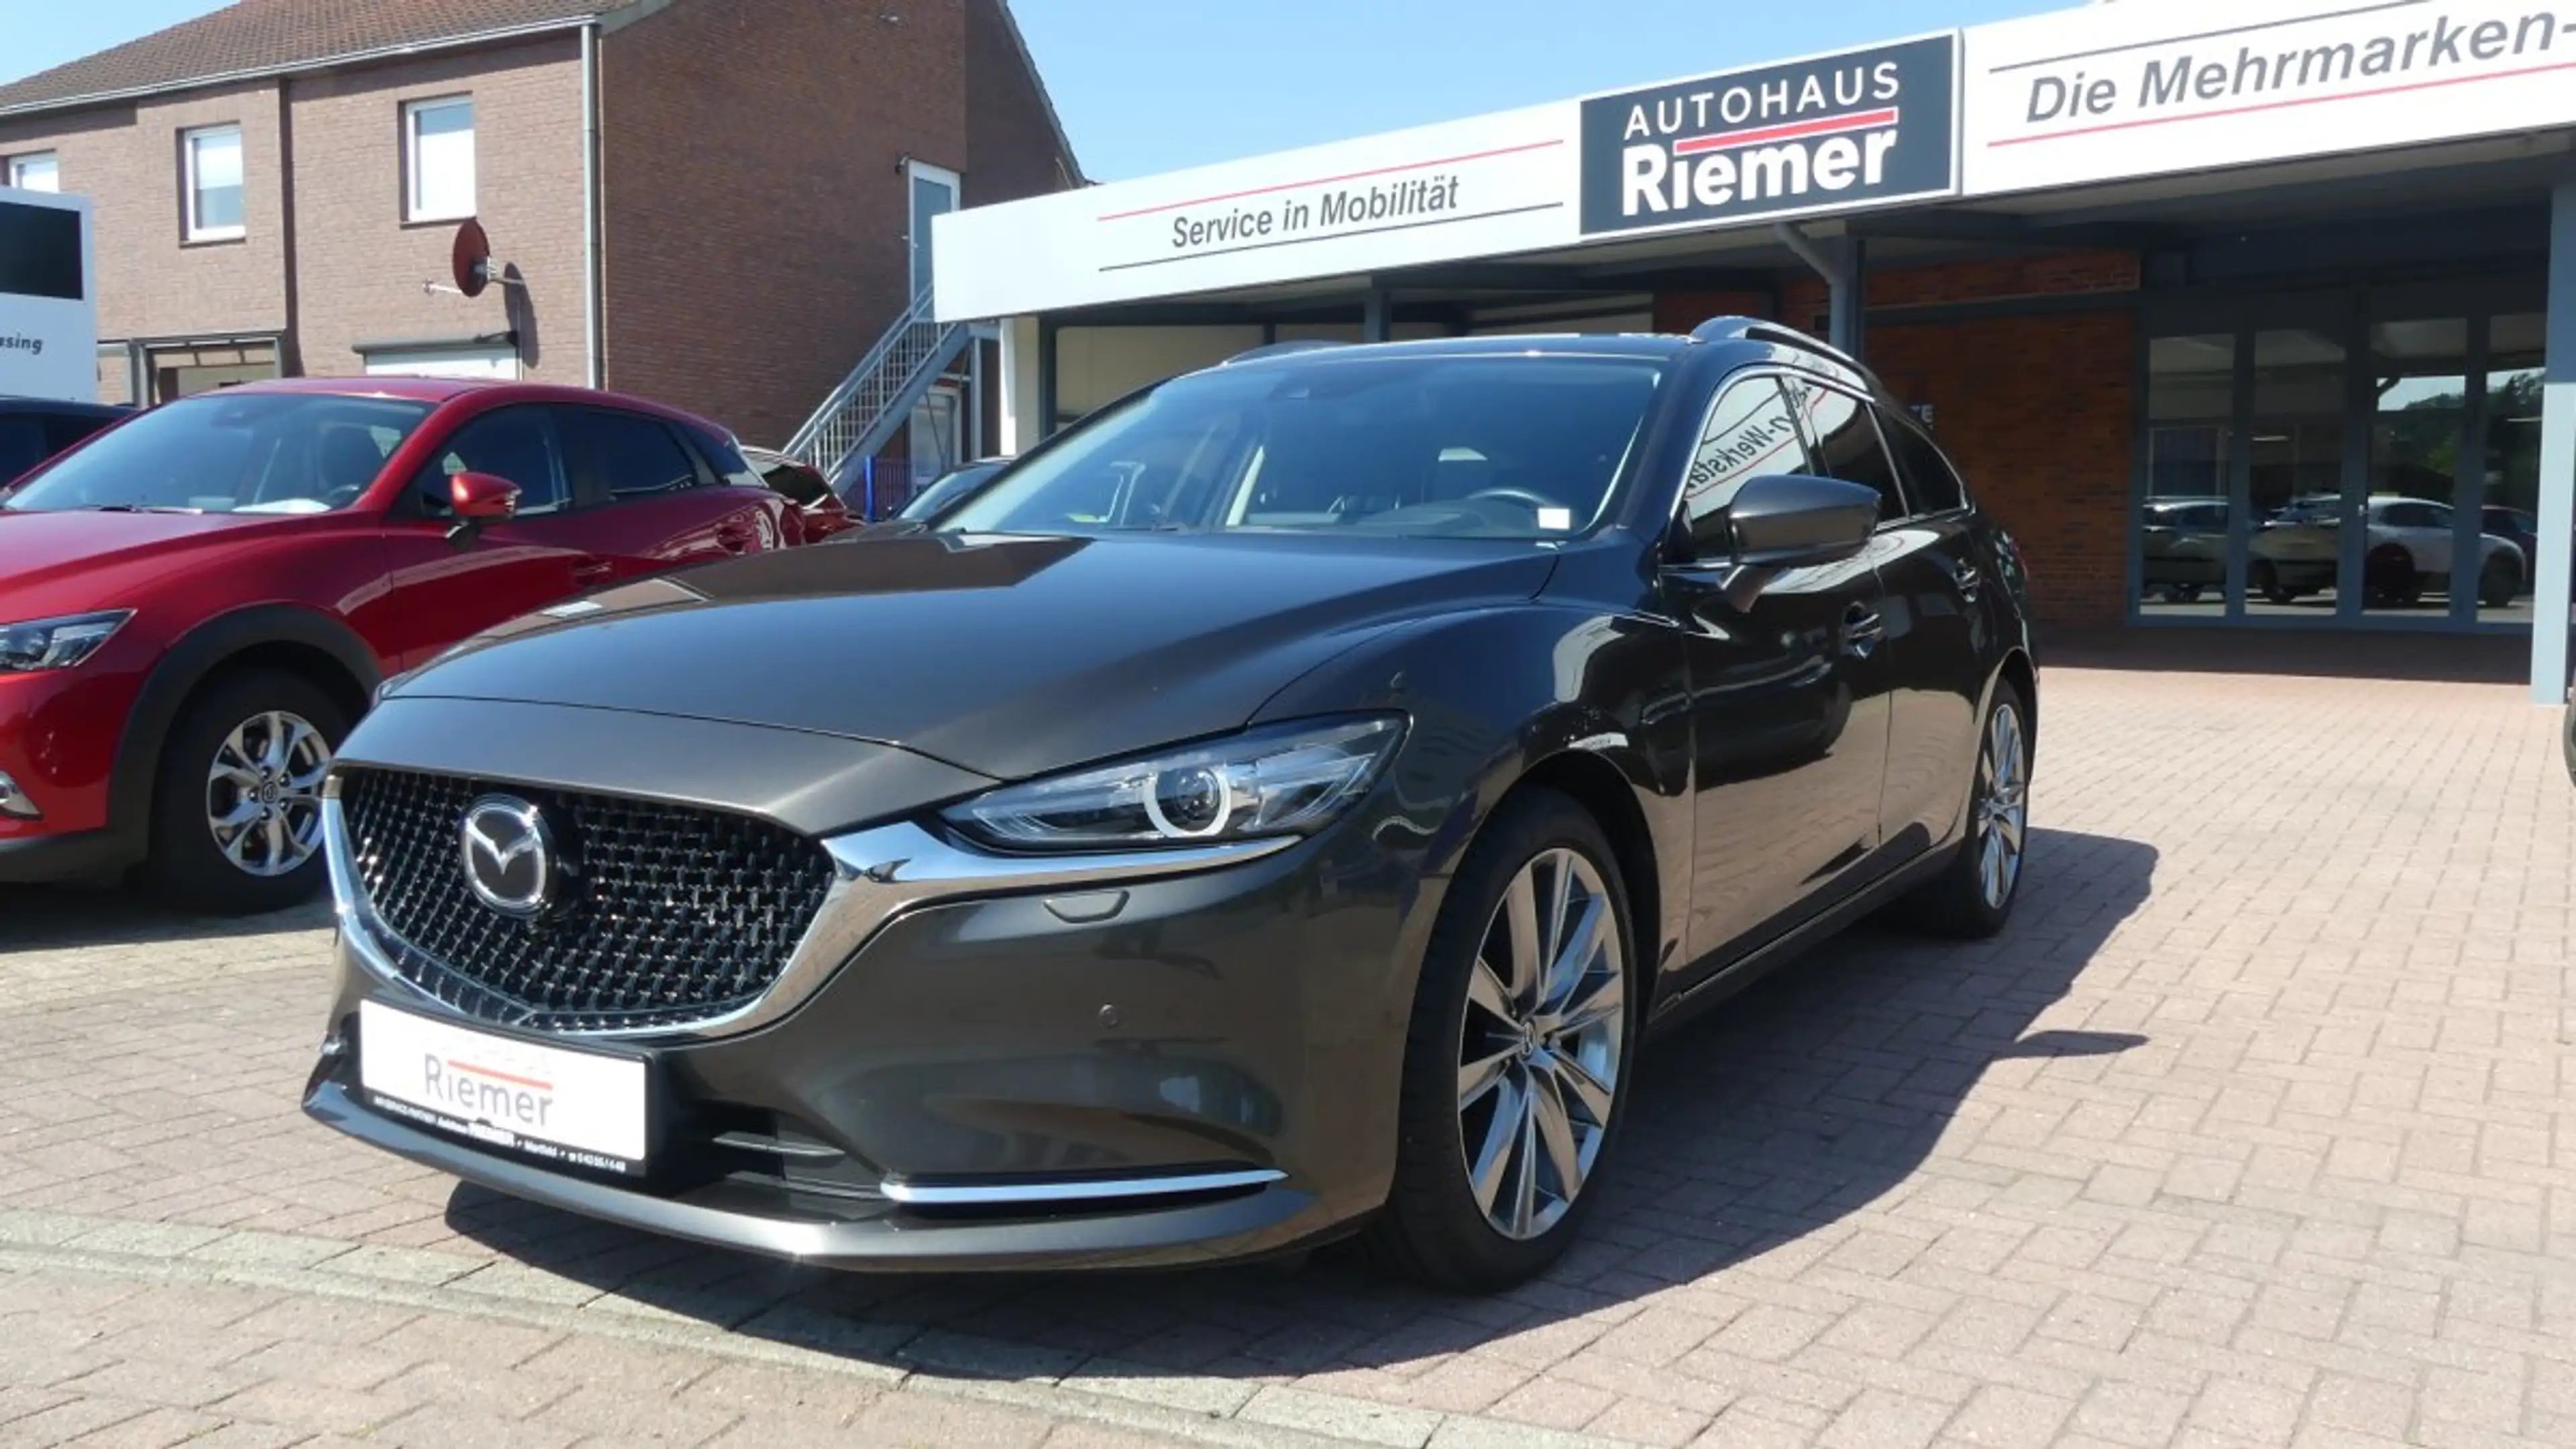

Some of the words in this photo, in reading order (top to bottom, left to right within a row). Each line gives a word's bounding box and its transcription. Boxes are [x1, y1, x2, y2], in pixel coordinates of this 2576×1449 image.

[1623, 61, 1900, 141] AUTOHAUS
[2026, 71, 2116, 123] Die
[2138, 12, 2576, 107] Mehrmarken-
[1173, 209, 1273, 248] Service
[1283, 199, 1309, 230] in
[1320, 175, 1458, 227] Mobilität
[1622, 128, 1898, 217] Riemer
[423, 1052, 554, 1127] Riemer
